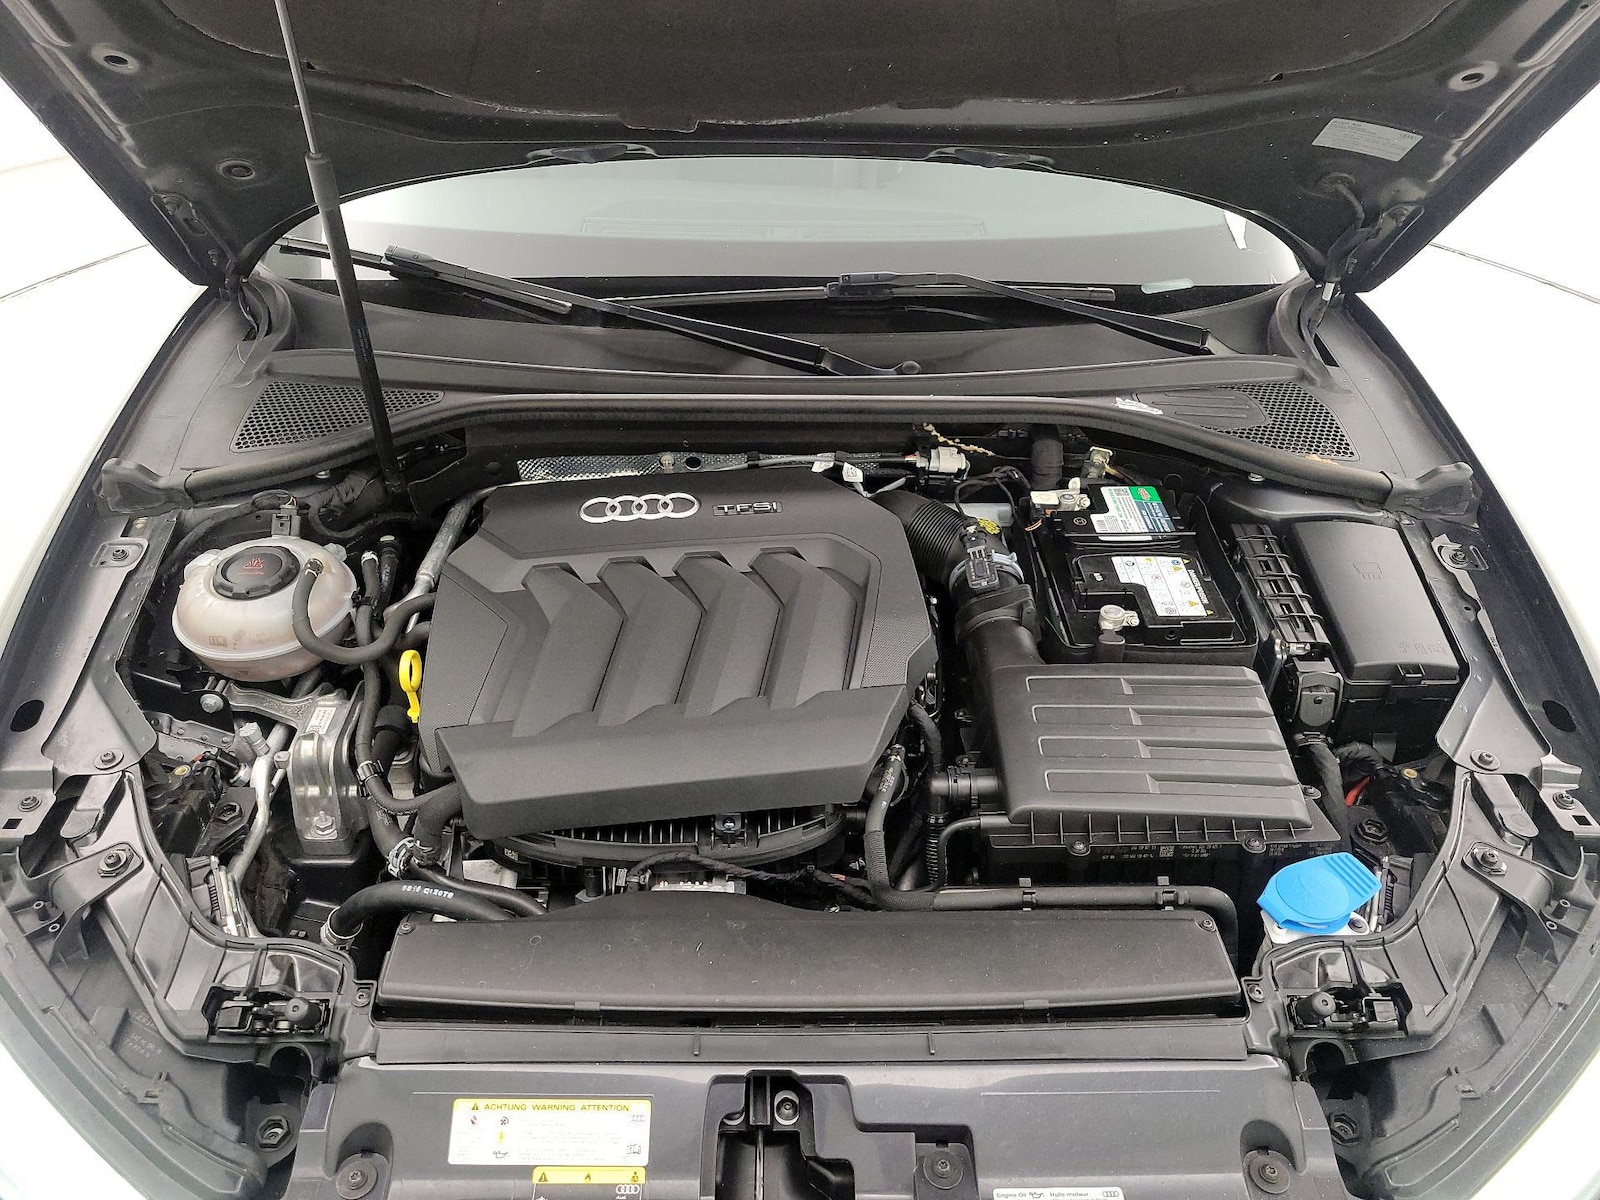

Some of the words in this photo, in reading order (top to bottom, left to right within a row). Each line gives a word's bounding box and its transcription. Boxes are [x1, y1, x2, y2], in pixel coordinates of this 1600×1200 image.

[715, 501, 779, 516] TFSI
[484, 1103, 527, 1111] ACHTUNG
[580, 1104, 630, 1112] ATTENTION
